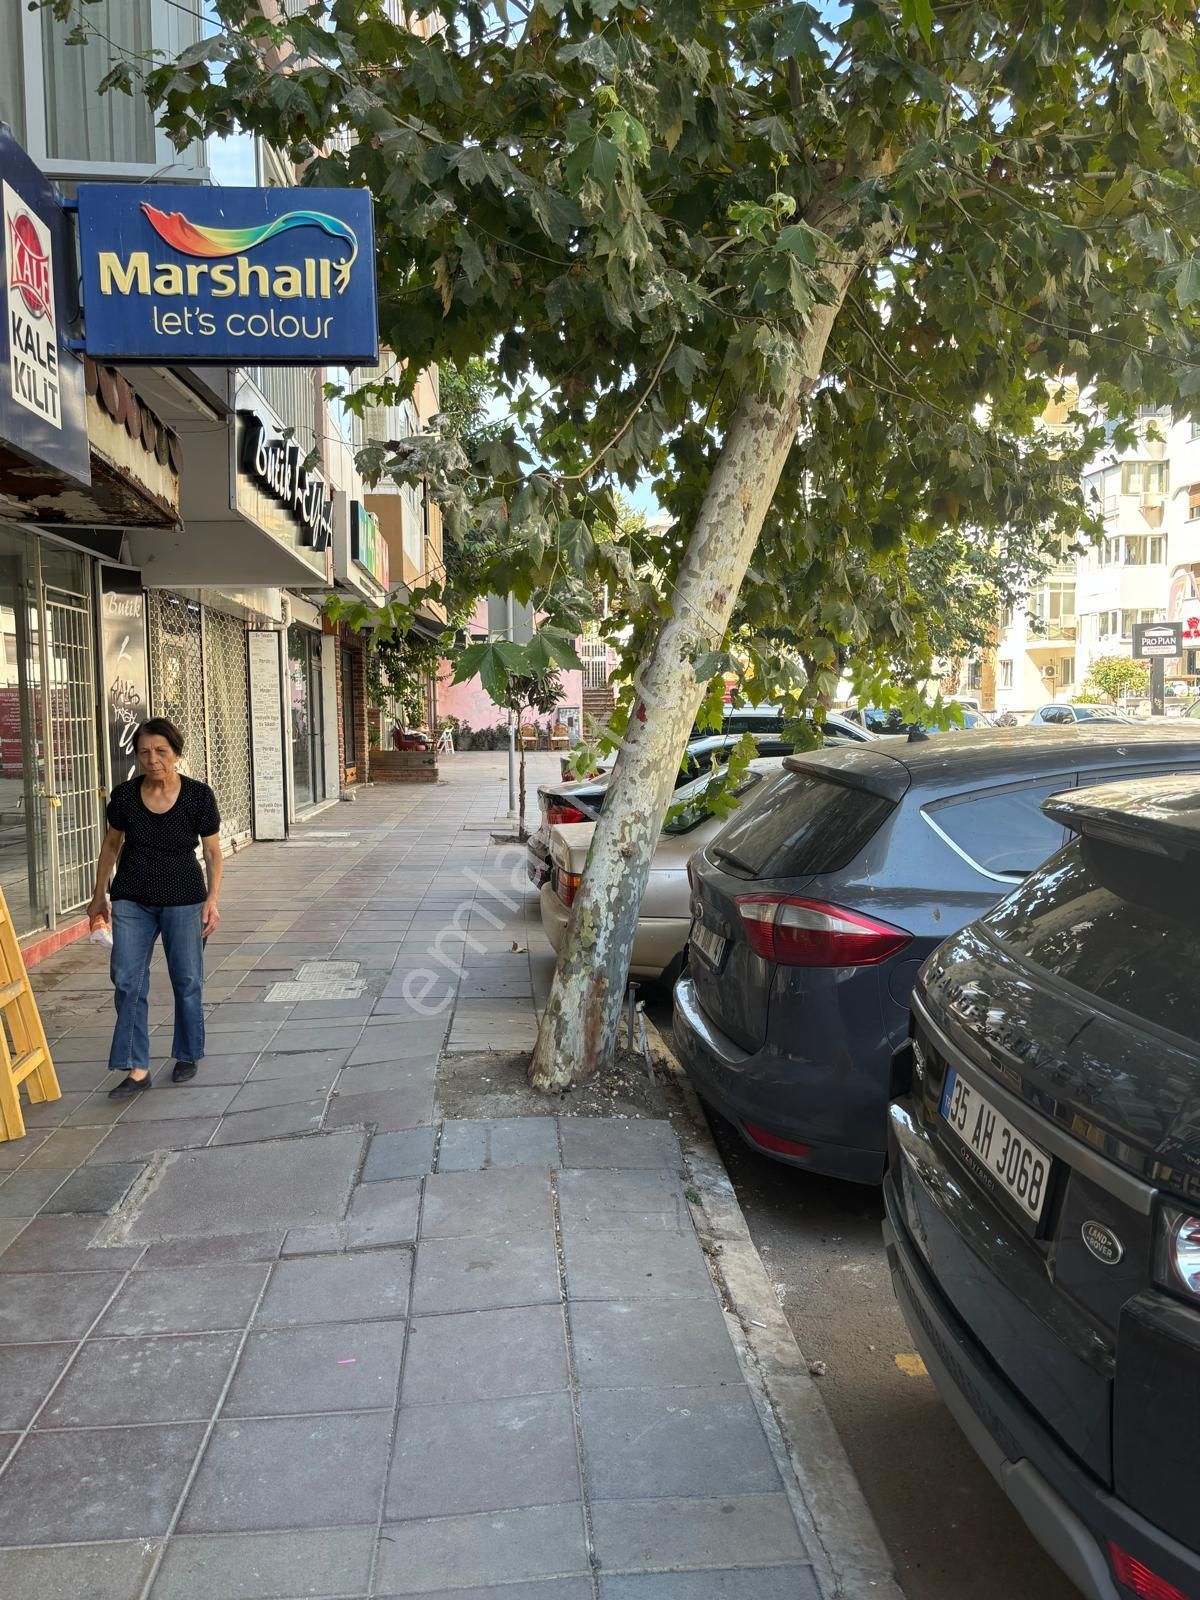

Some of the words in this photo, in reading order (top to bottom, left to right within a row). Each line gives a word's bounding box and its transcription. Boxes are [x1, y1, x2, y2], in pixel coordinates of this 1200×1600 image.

[10, 224, 50, 304] KALE
[98, 251, 331, 299] Marshall
[12, 310, 57, 377] KALE
[152, 305, 217, 336] let's
[226, 308, 334, 339] colour
[254, 411, 292, 501] Butik
[106, 591, 141, 618] Butik
[950, 1079, 970, 1131] 35
[971, 1103, 996, 1160] AH
[996, 1127, 1045, 1212] 3068
[1088, 1225, 1108, 1245] LAND
[1089, 1236, 1113, 1259] ROVER
